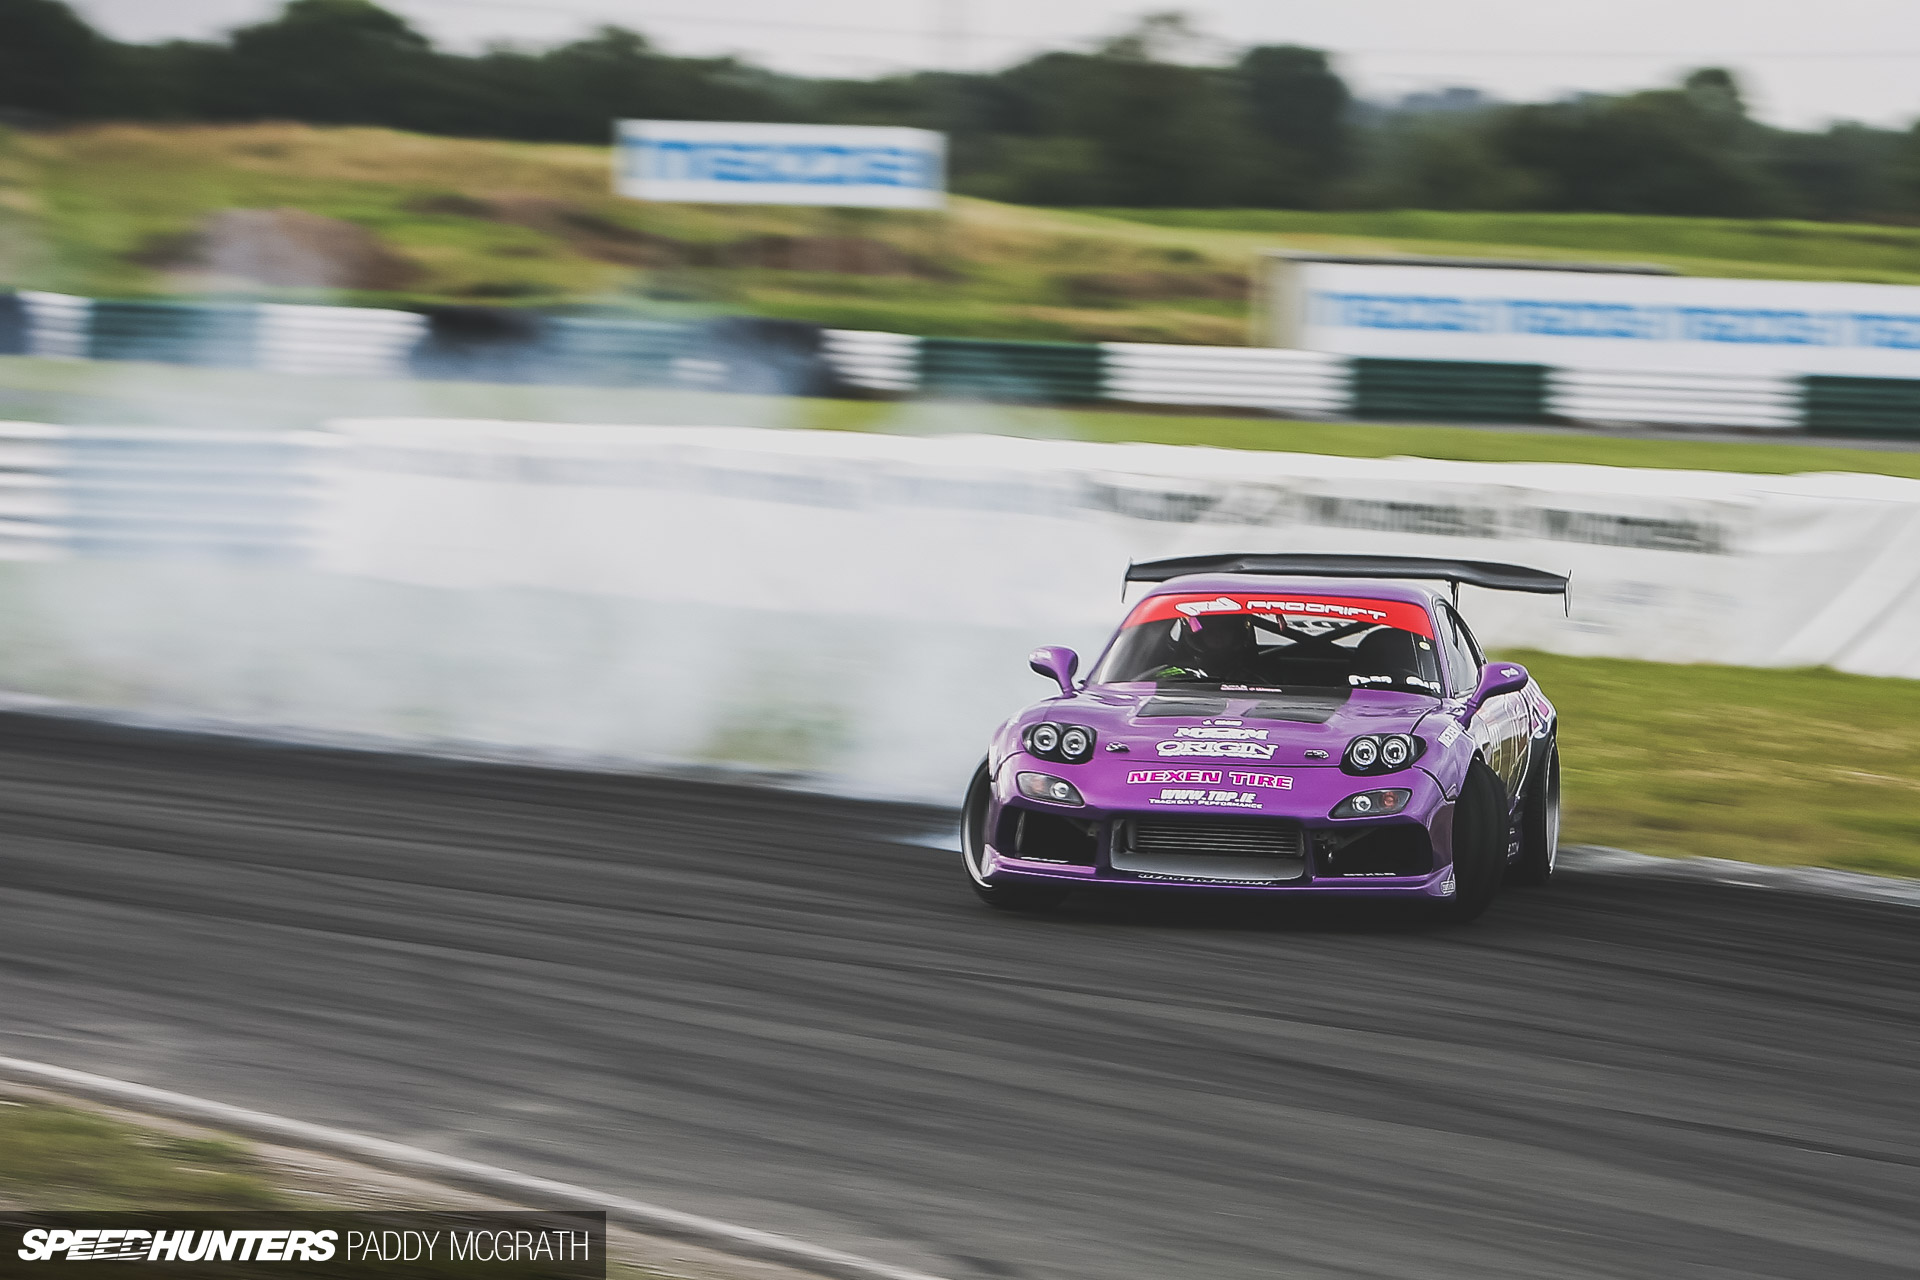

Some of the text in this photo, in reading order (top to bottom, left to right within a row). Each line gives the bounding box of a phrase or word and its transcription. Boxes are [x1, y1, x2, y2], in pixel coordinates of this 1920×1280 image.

[1246, 600, 1387, 620] PRODRIFT
[1156, 740, 1279, 757] ORIGIN
[1127, 770, 1293, 790] NEXEN TIRE
